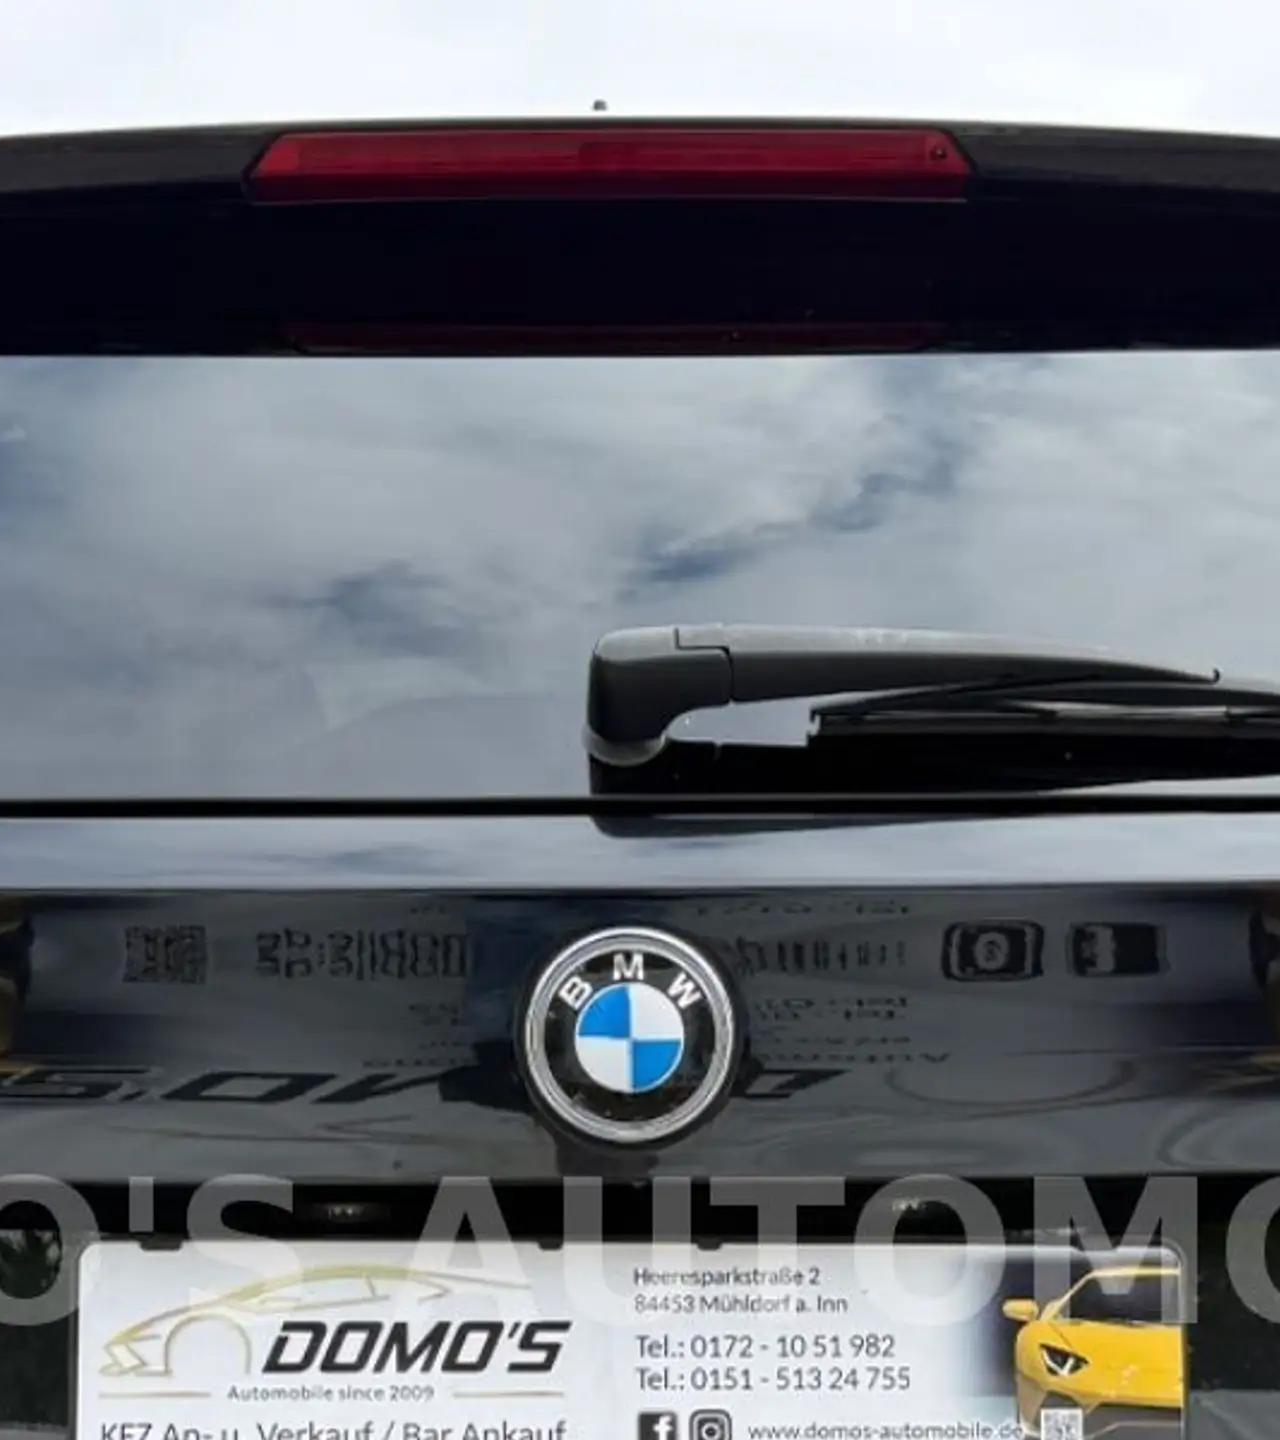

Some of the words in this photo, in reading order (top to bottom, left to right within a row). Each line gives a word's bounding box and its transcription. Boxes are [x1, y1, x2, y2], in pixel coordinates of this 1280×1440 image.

[558, 952, 703, 1011] BMW
[633, 1266, 803, 1288] Heeresparkstraße
[808, 1266, 821, 1286] 2
[634, 1294, 696, 1314] 84453
[699, 1294, 790, 1314] Mühldorf
[817, 1295, 848, 1314] Inn
[262, 1320, 572, 1374] DOMO'S
[637, 1335, 685, 1358] Tel.:
[691, 1335, 753, 1358] 0172
[776, 1335, 807, 1358] 10
[813, 1335, 843, 1358] 51
[848, 1334, 896, 1358] 982
[637, 1367, 685, 1391] Tel.:
[691, 1367, 753, 1391] 0151
[776, 1366, 822, 1391] 513
[828, 1366, 859, 1391] 24
[865, 1366, 910, 1391] 755
[227, 1383, 333, 1402] Automobile
[338, 1384, 386, 1402] since
[390, 1384, 435, 1401] 2009
